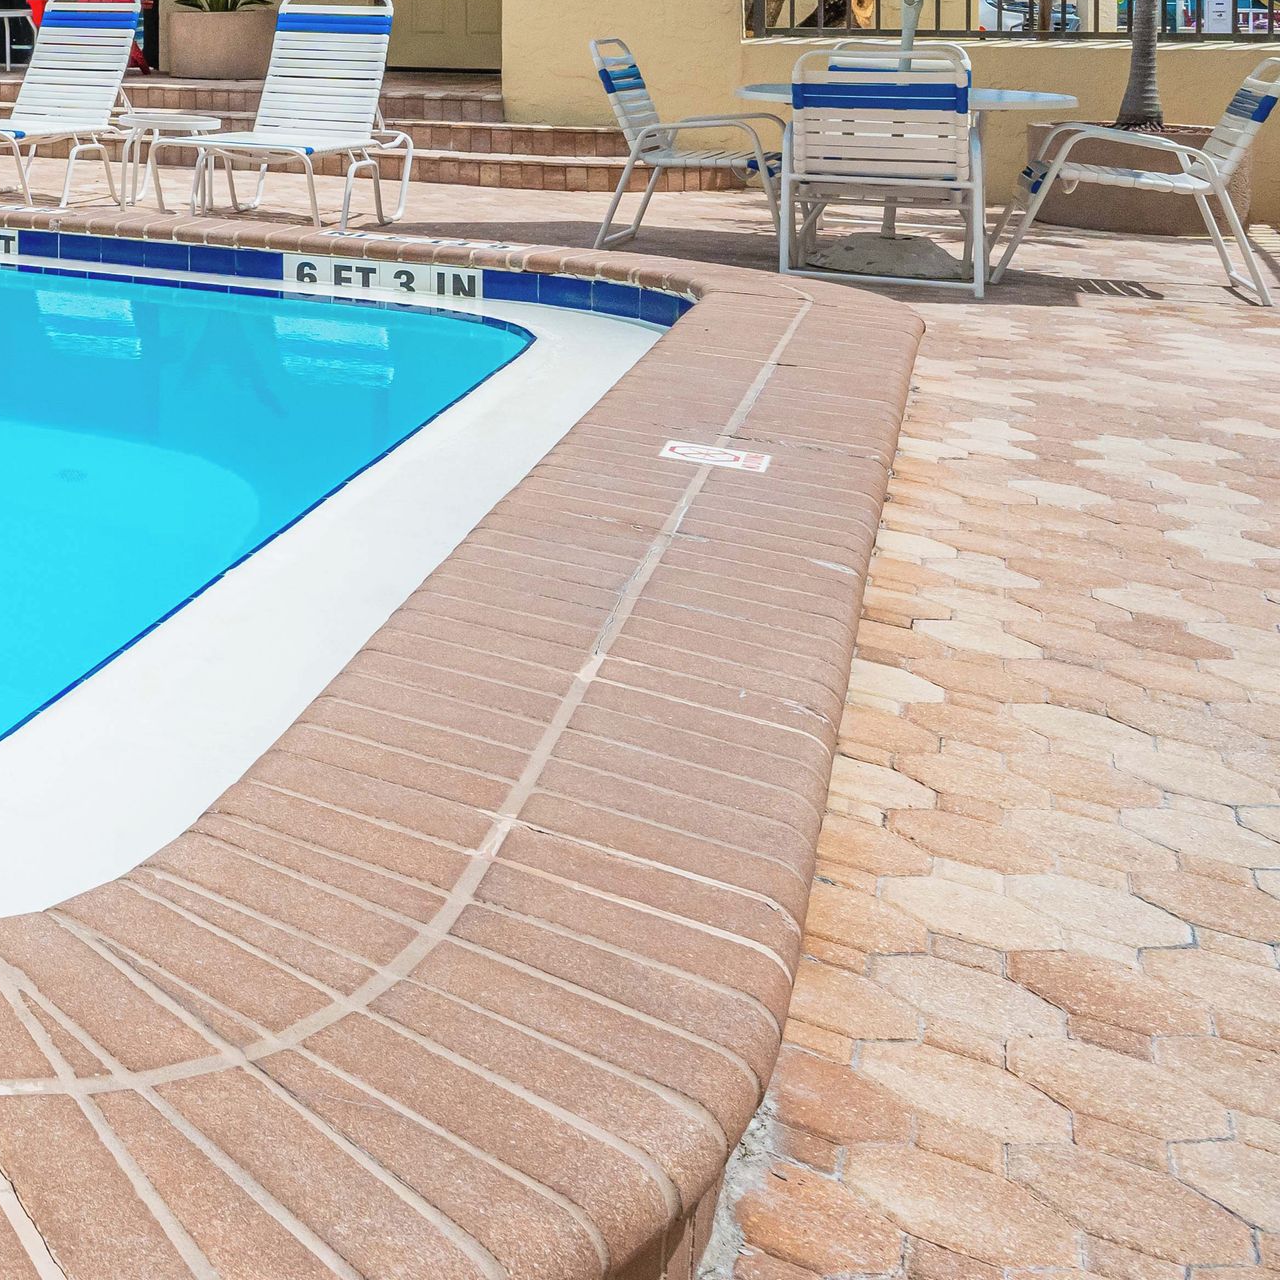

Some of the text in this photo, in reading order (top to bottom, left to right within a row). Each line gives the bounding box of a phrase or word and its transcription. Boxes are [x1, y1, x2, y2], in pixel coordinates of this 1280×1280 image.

[296, 261, 476, 298] 6 FT 3 IN
